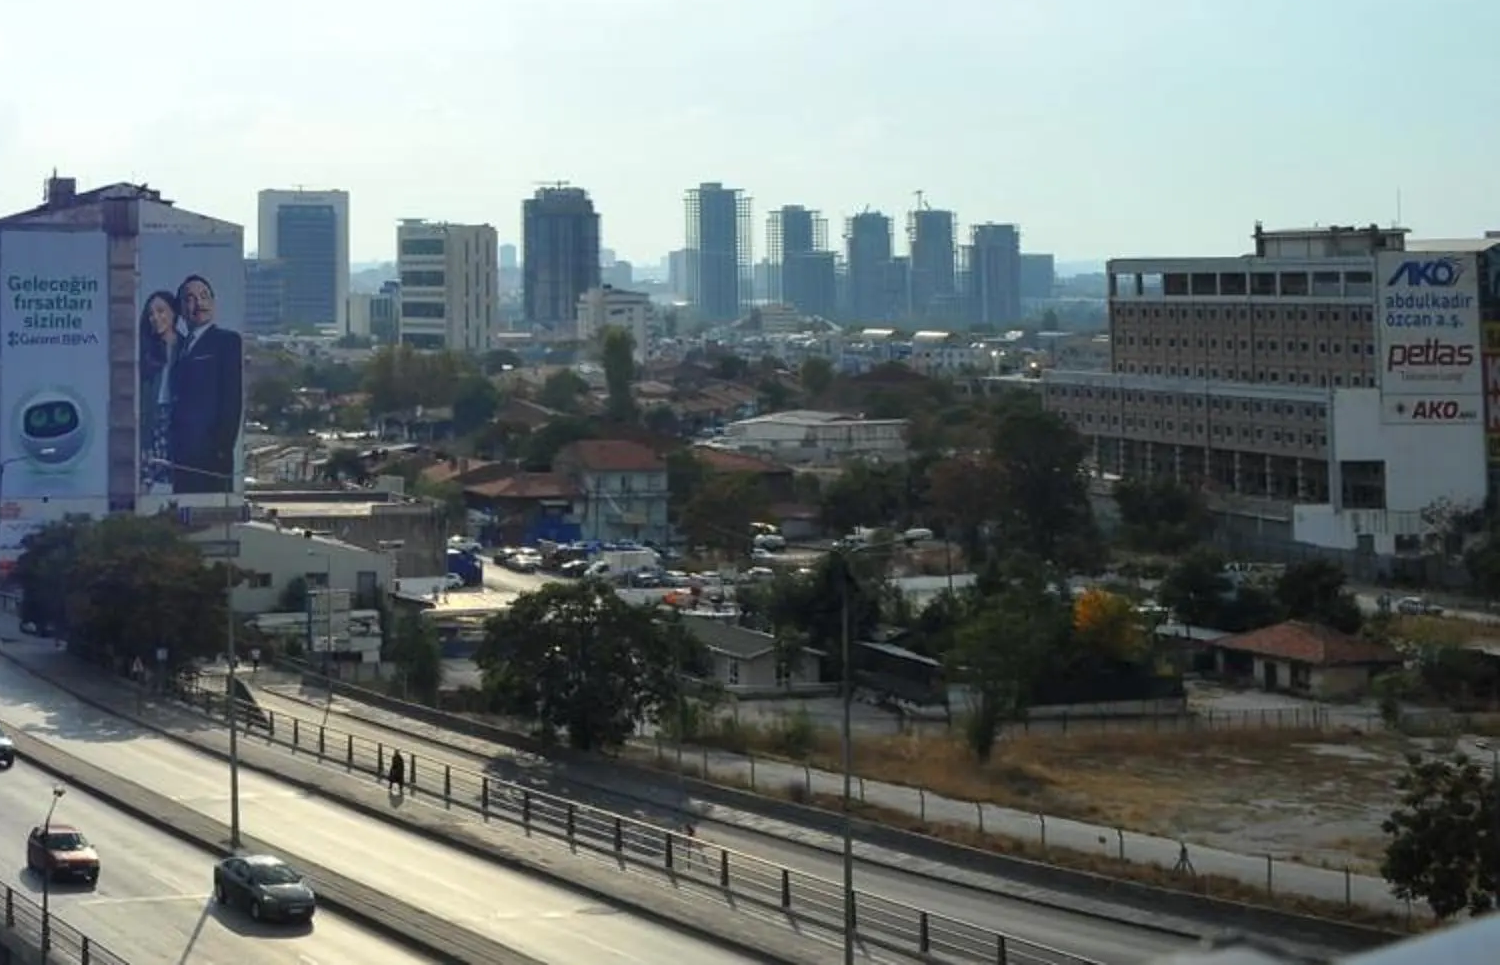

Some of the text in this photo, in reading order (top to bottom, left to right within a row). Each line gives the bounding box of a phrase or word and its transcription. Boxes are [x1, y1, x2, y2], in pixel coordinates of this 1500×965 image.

[7, 275, 98, 295] Geleceğin
[14, 295, 92, 310] fırsatları
[1386, 292, 1473, 309] abdulkadir
[23, 313, 82, 329] sizinle
[1388, 337, 1473, 372] petlas
[1412, 401, 1458, 420] AKO
